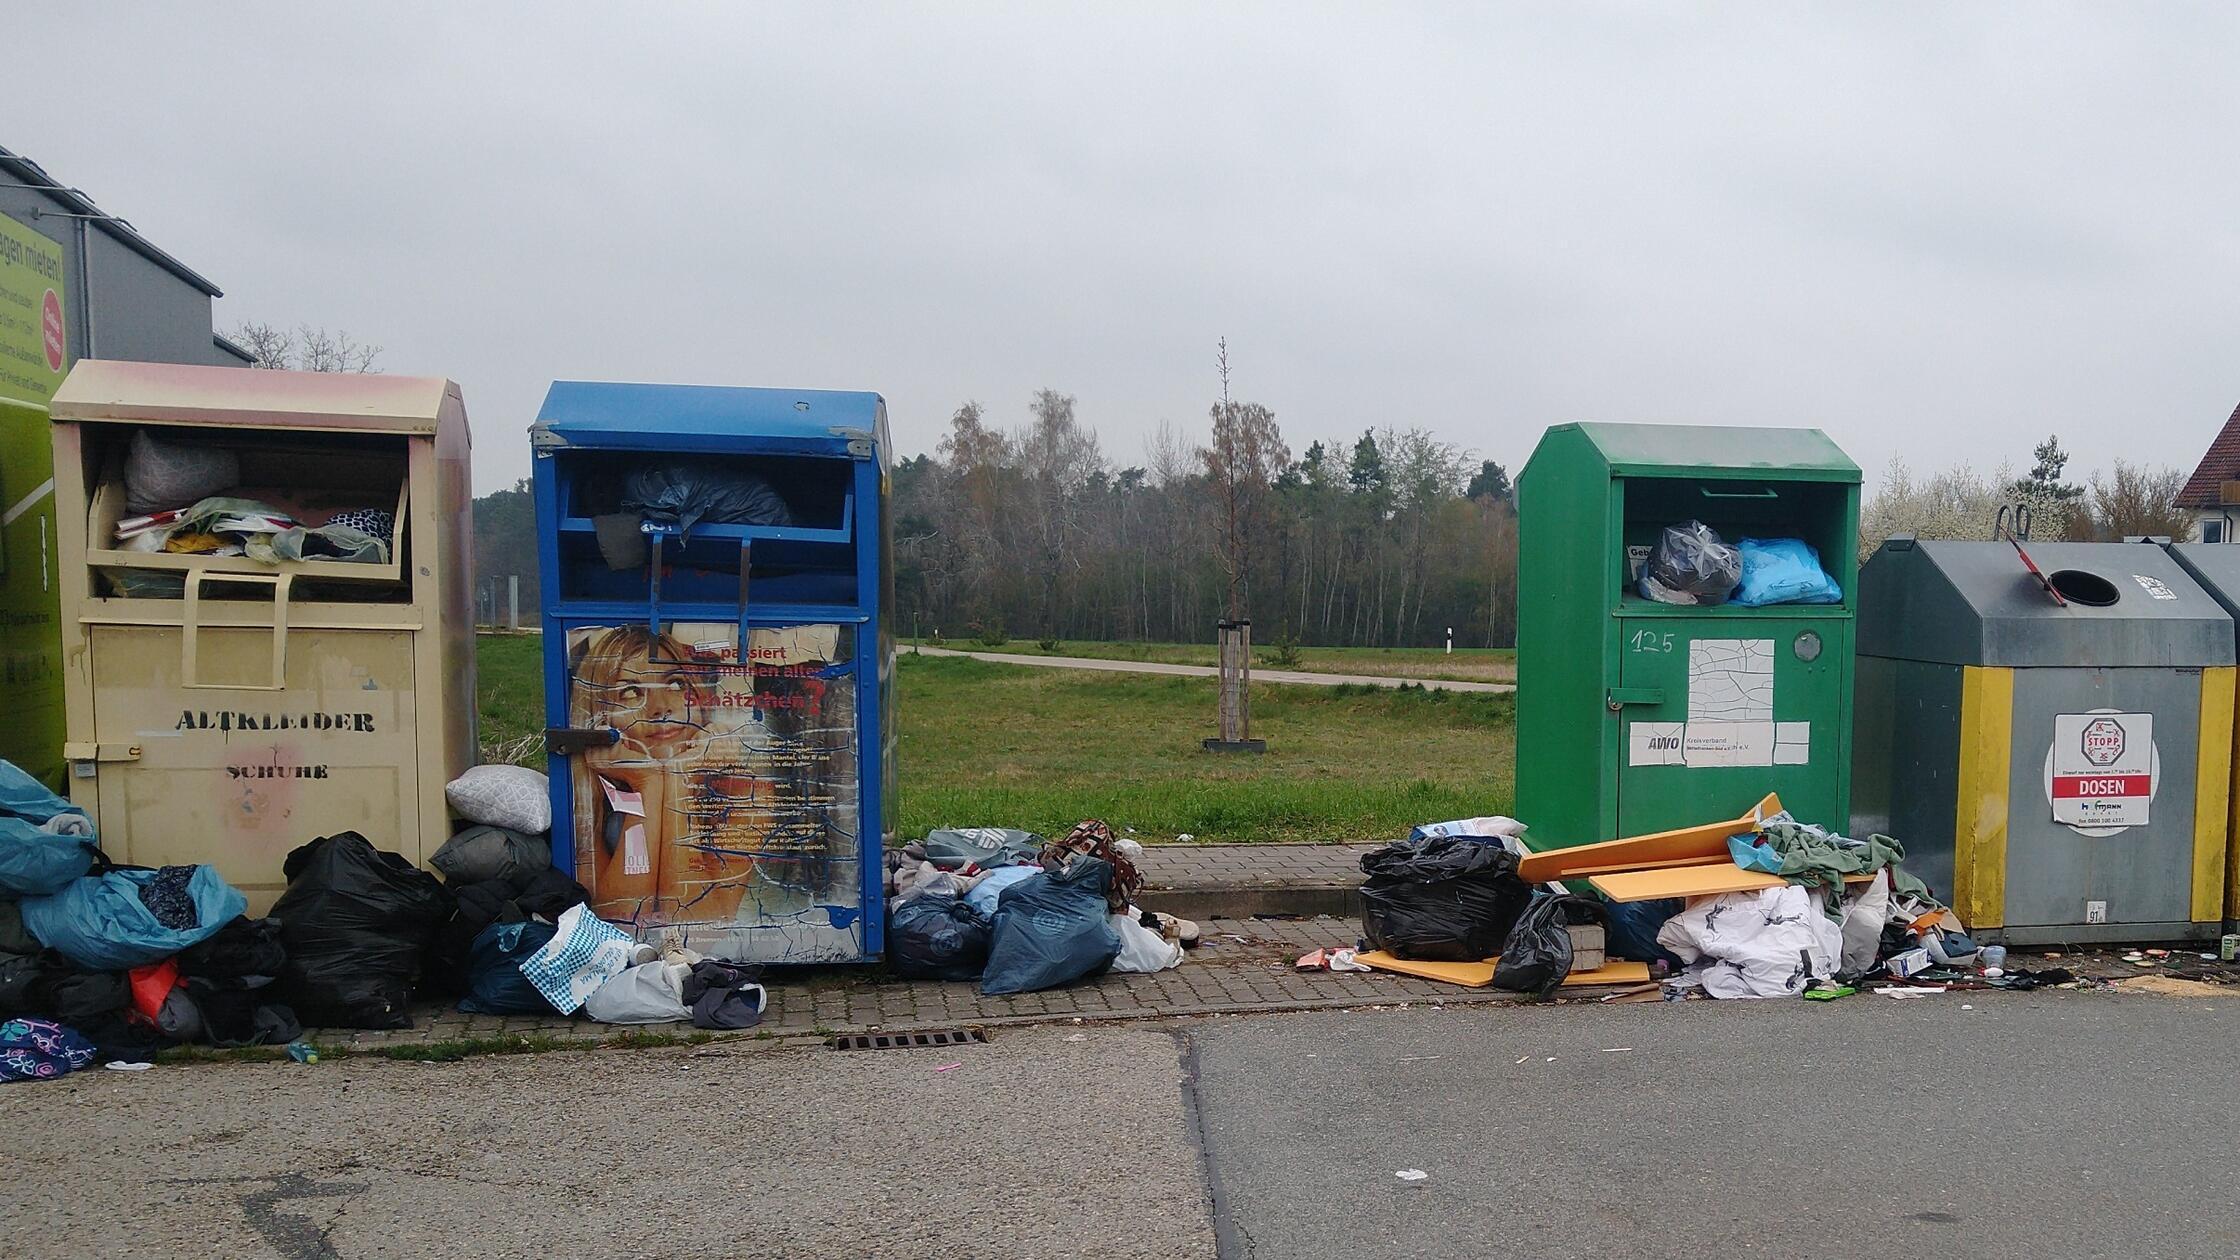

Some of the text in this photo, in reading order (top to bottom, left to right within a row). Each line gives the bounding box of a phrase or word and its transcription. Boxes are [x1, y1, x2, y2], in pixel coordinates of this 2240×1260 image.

[1631, 629, 1675, 653] 125
[175, 710, 375, 733] ALTKLEIDER
[1648, 737, 1679, 750] AWO
[2088, 737, 2119, 746] STOPP
[2080, 779, 2125, 795] DOSEN
